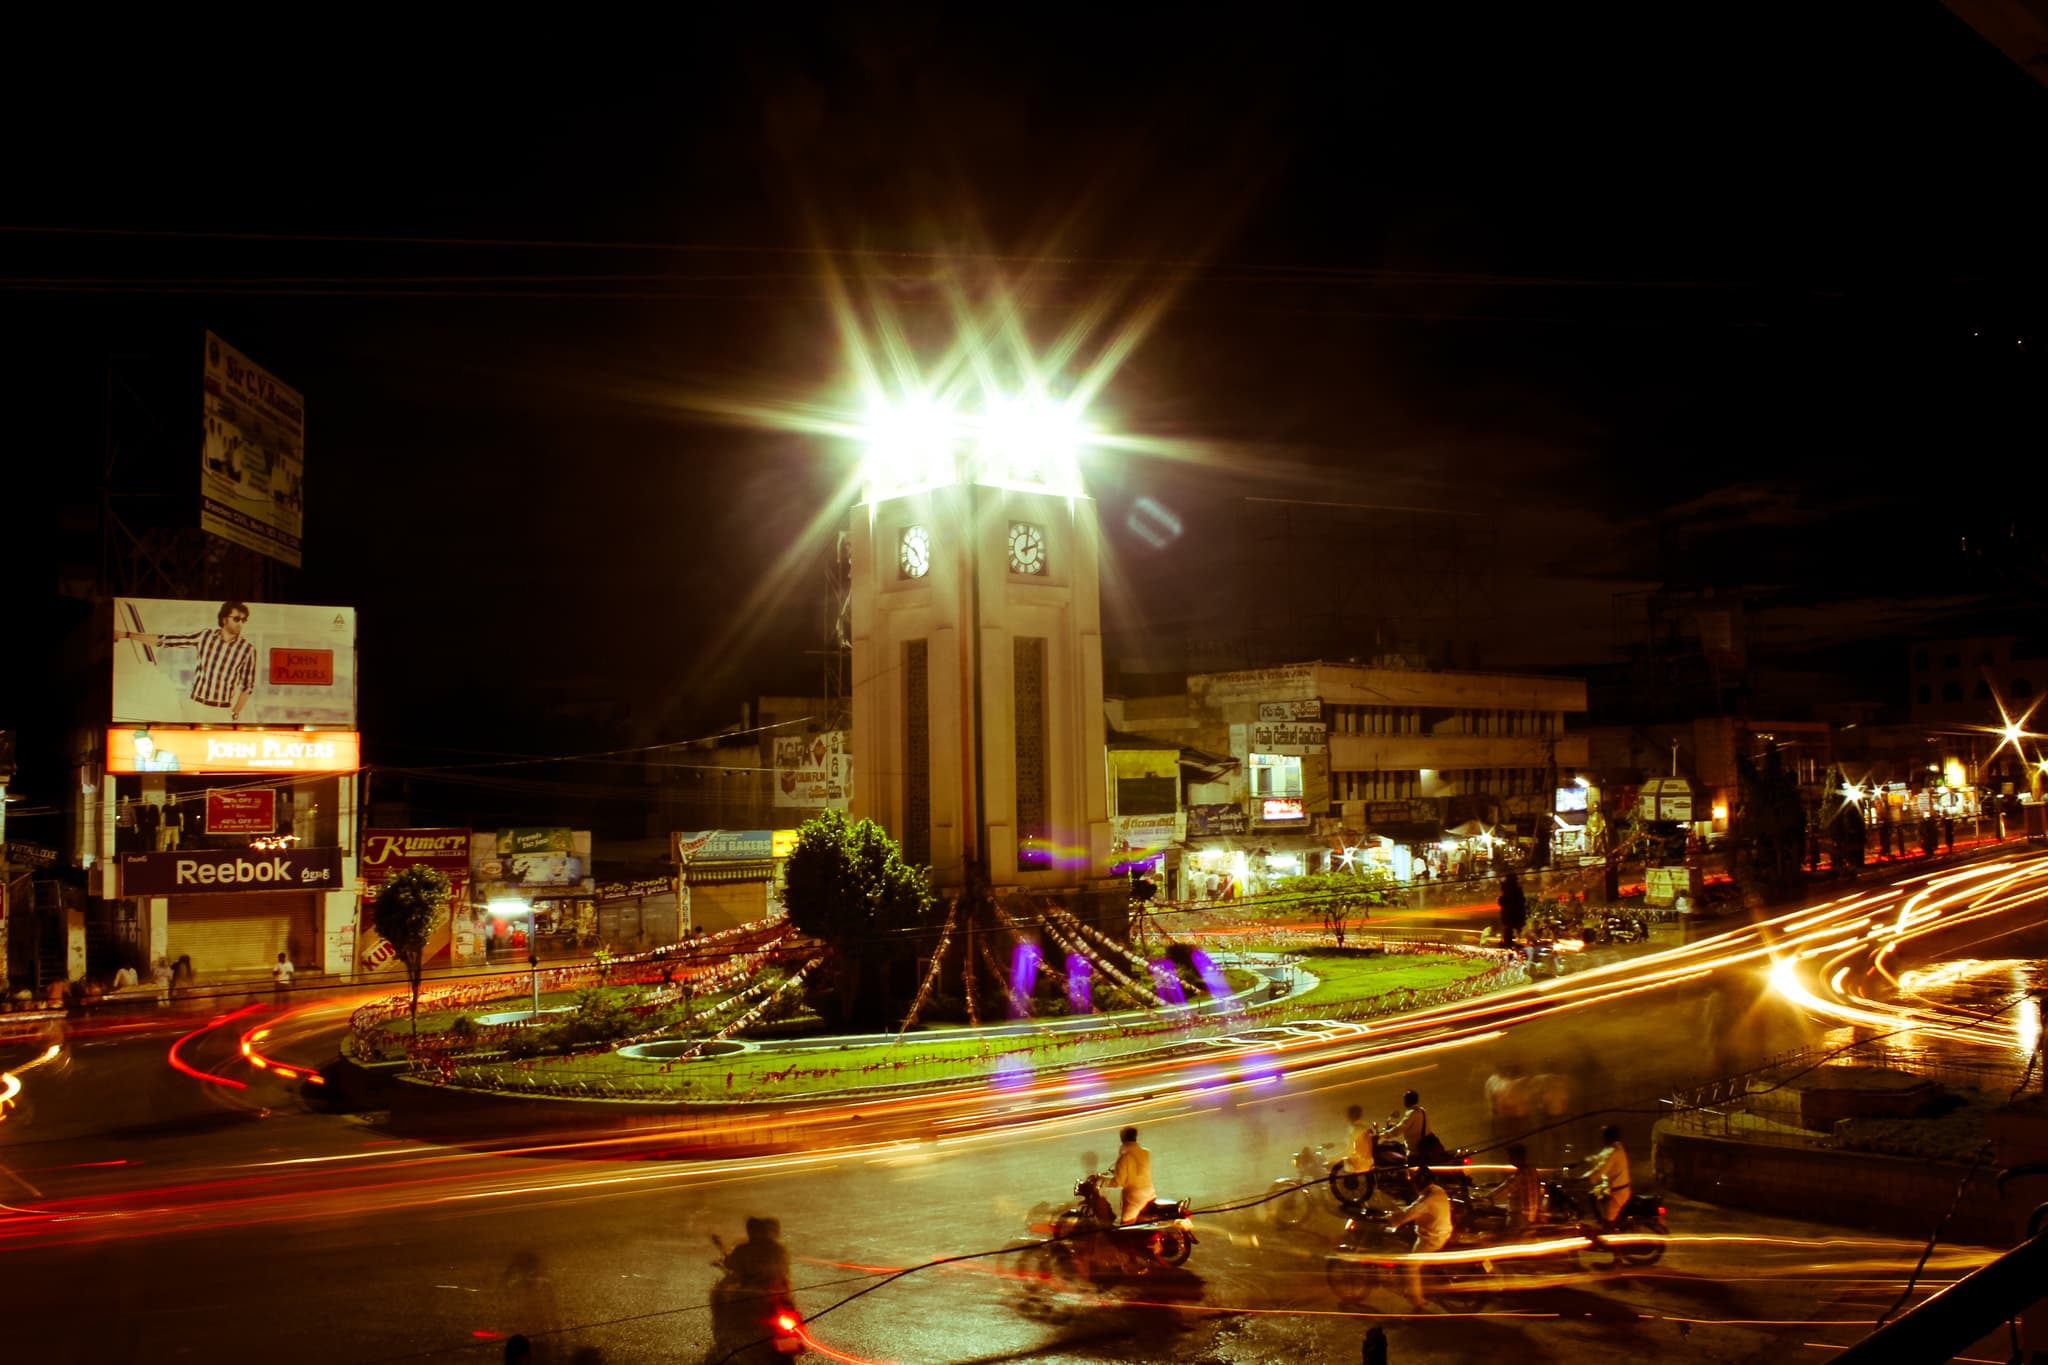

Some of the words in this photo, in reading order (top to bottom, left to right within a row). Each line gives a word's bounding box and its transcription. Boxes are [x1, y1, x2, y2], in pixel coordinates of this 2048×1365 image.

[227, 355, 243, 387] Sir
[287, 653, 319, 667] JOHN
[277, 666, 327, 680] PLAYERS
[207, 738, 257, 762] JOHN
[262, 737, 335, 759] PLAYERS
[775, 742, 813, 767] AGFA
[363, 835, 466, 865] Kumar
[729, 840, 771, 851] BAKERS
[176, 858, 292, 884] Reebok
